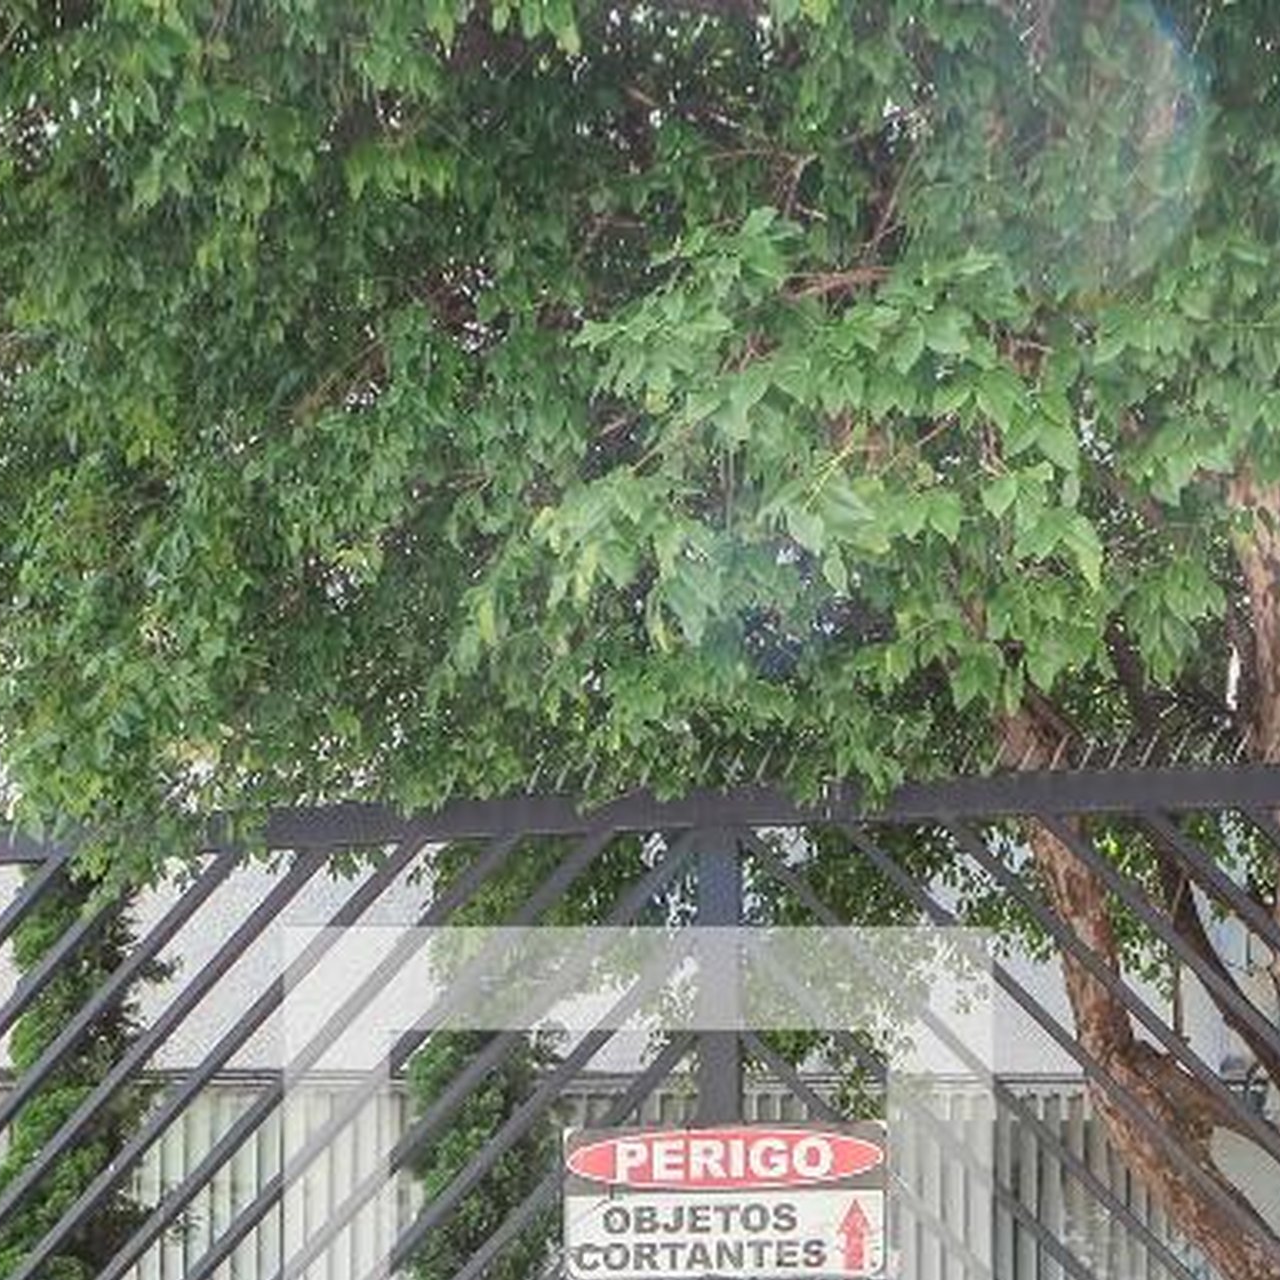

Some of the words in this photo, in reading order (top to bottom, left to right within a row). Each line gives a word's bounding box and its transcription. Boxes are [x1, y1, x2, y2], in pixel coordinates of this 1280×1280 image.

[613, 1138, 835, 1182] PERIGO
[603, 1202, 798, 1235] OBJETOS
[575, 1239, 828, 1272] CORTANTES
